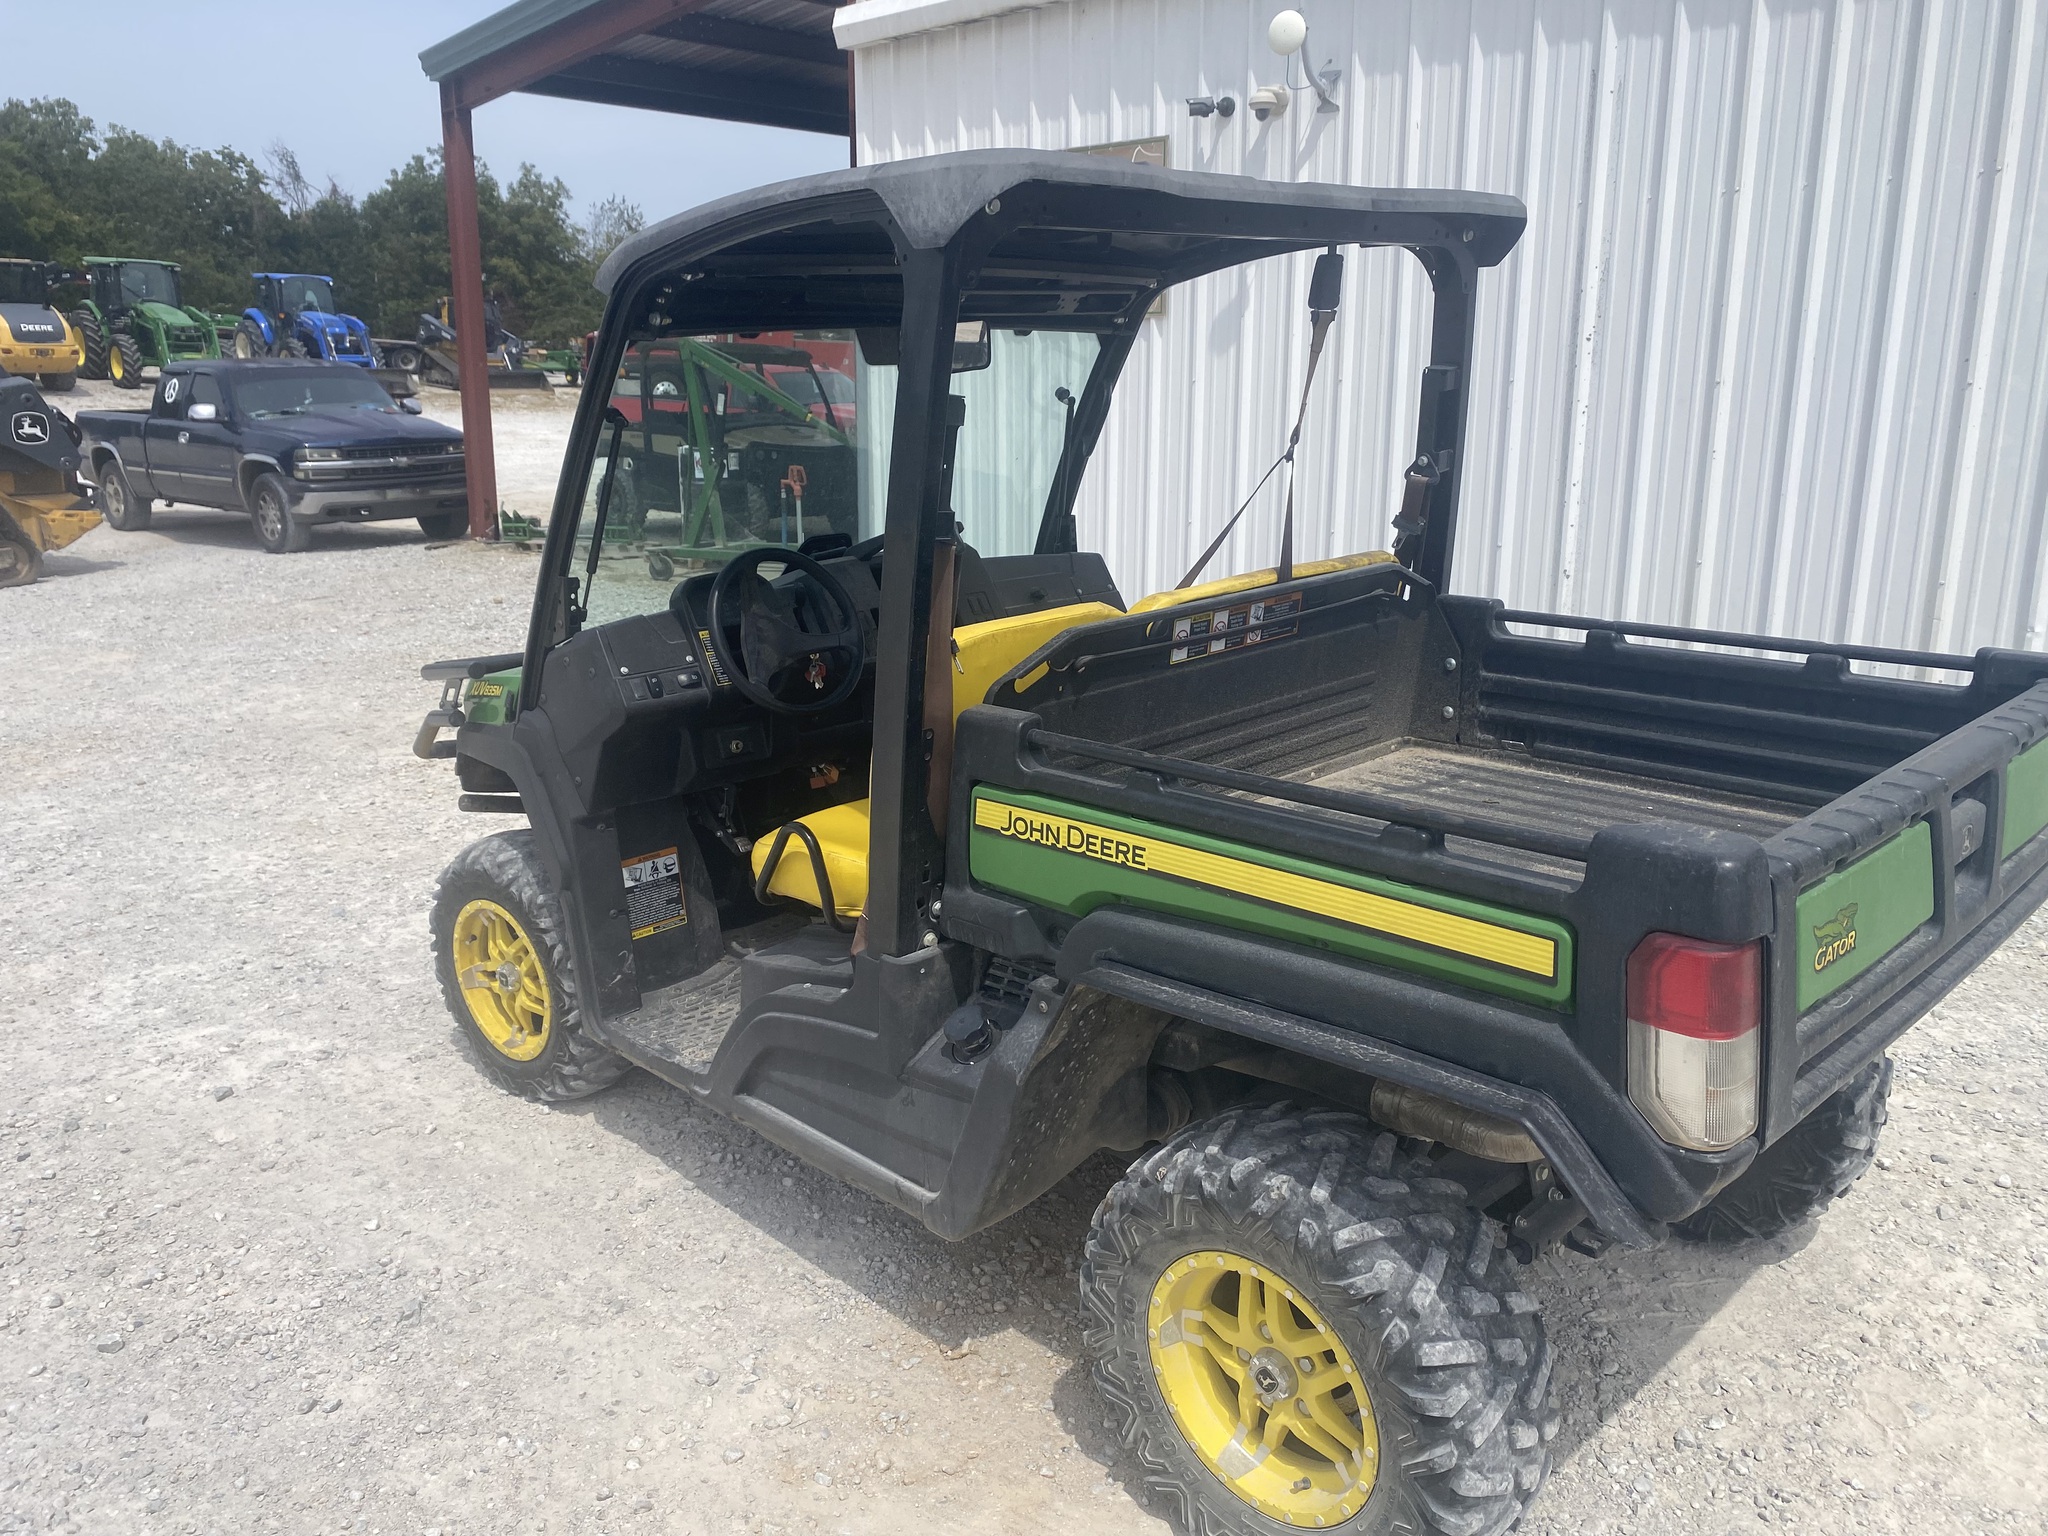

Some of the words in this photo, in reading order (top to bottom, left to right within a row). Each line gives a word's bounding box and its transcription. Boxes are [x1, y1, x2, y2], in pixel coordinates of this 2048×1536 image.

[20, 323, 53, 332] DEERE
[1000, 811, 1061, 846] JOHN
[1067, 824, 1147, 867] DEERE
[1814, 930, 1856, 971] GATOR
